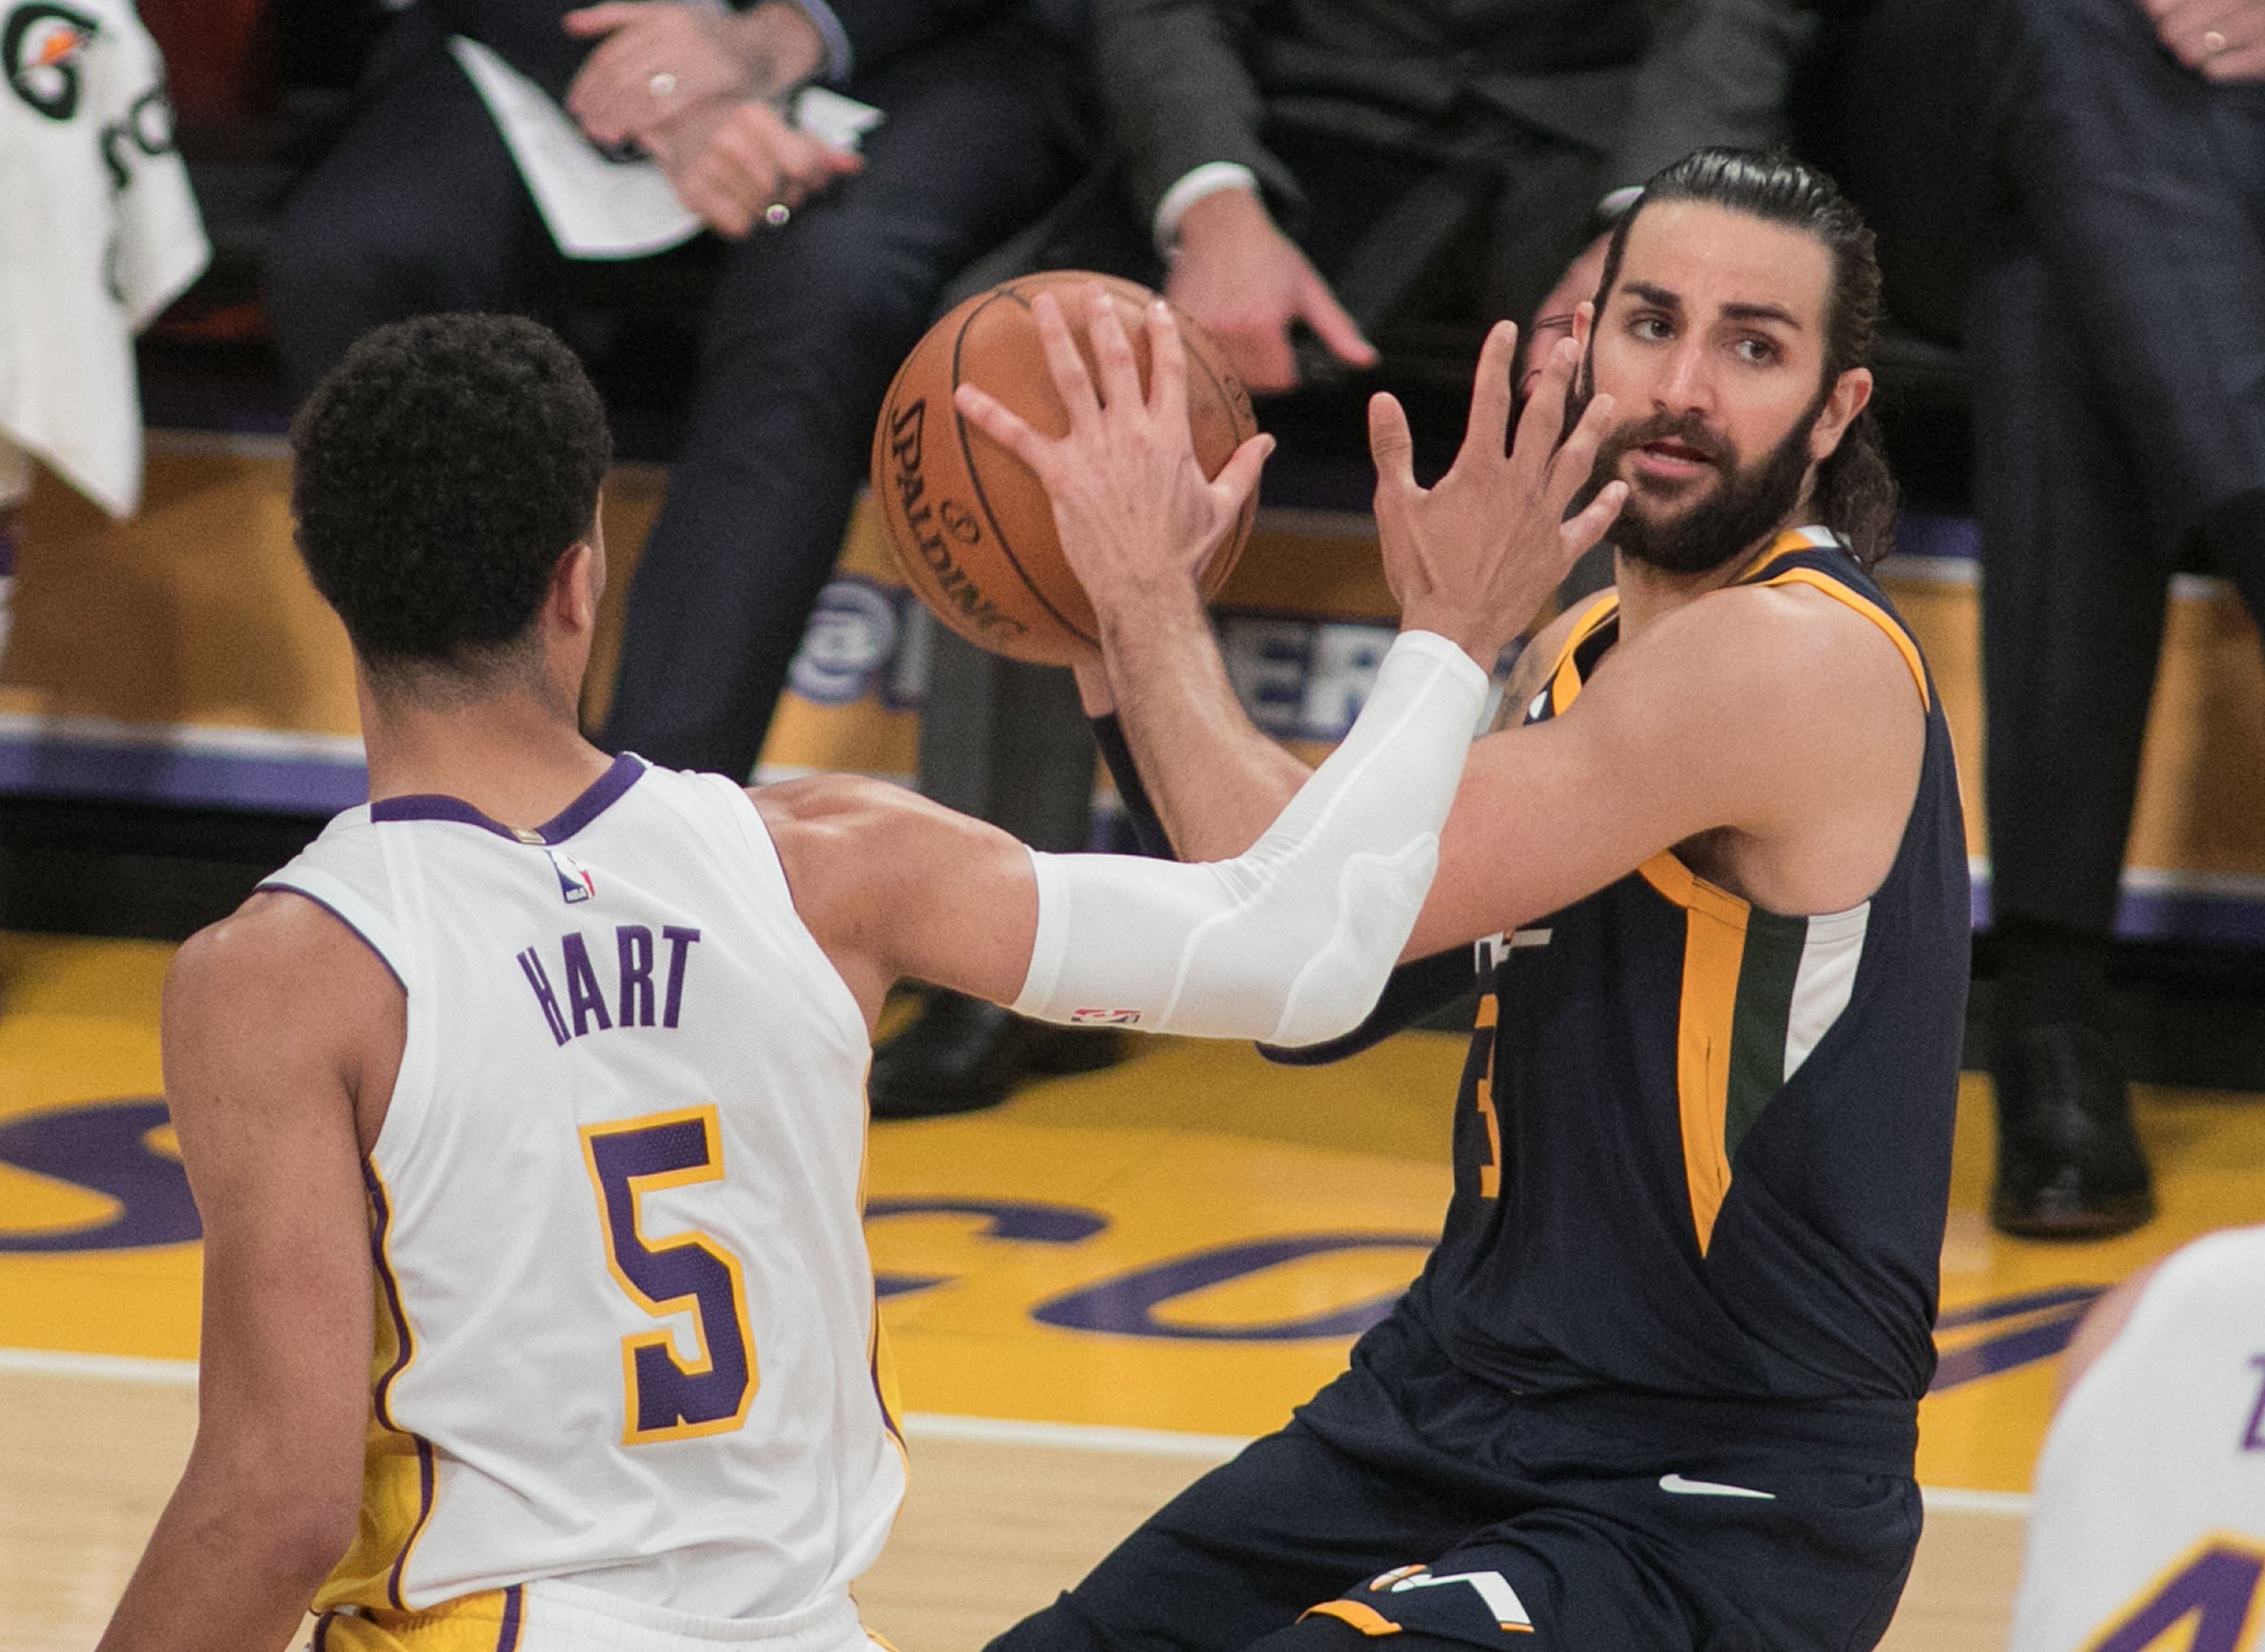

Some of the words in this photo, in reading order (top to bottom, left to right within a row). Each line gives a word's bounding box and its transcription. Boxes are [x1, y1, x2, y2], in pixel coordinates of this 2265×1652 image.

[889, 398, 1030, 647] SPALDING
[515, 924, 701, 1048] HART
[577, 1104, 761, 1446] 5
